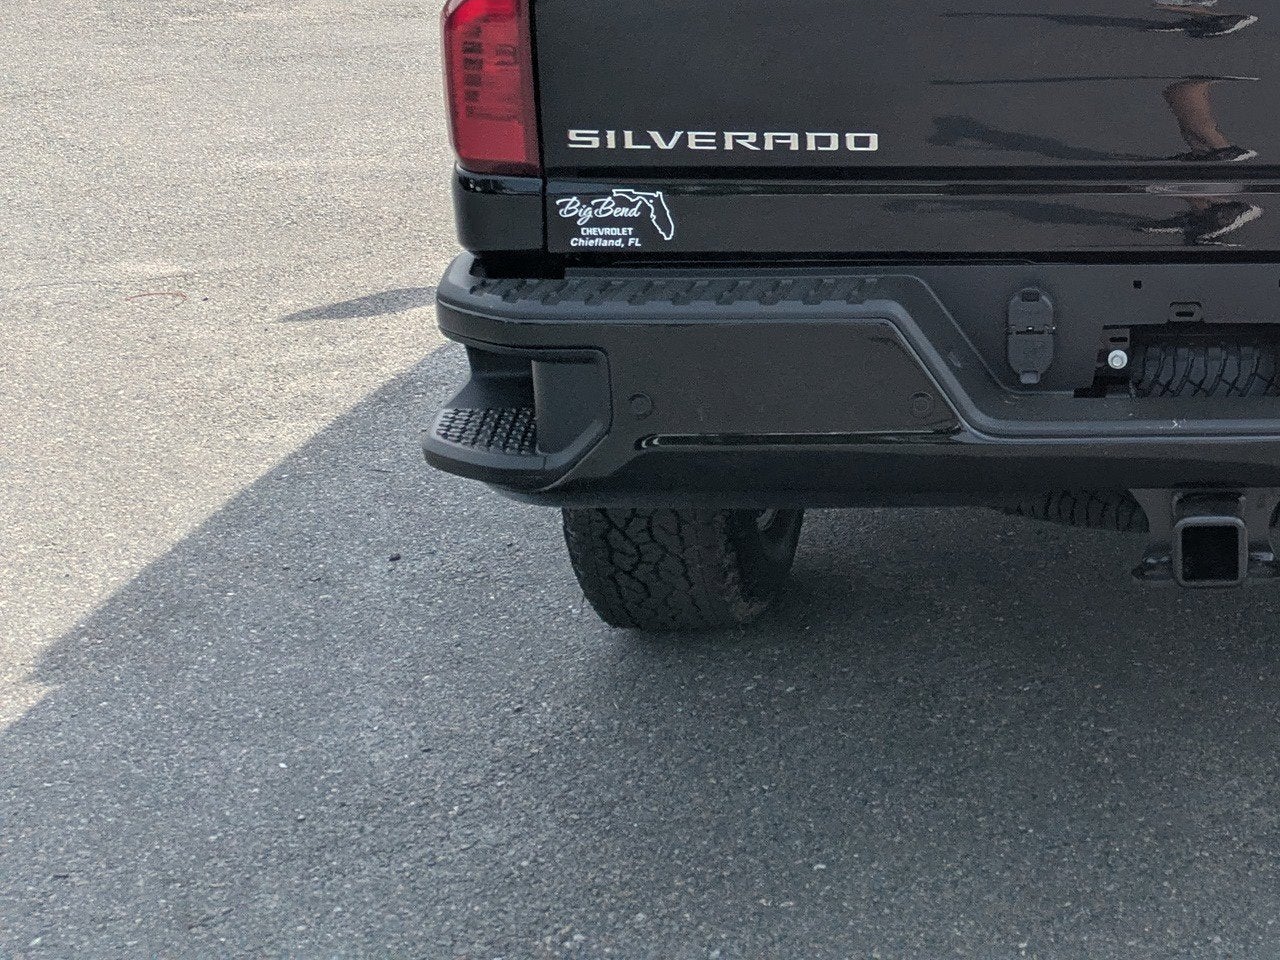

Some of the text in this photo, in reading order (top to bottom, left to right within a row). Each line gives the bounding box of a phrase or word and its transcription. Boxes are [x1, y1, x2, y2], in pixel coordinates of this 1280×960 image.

[566, 129, 879, 152] SILVERADO
[556, 196, 642, 226] Big Bend
[580, 227, 634, 236] CHEVROLET
[570, 237, 642, 248] Chiefland, FL
